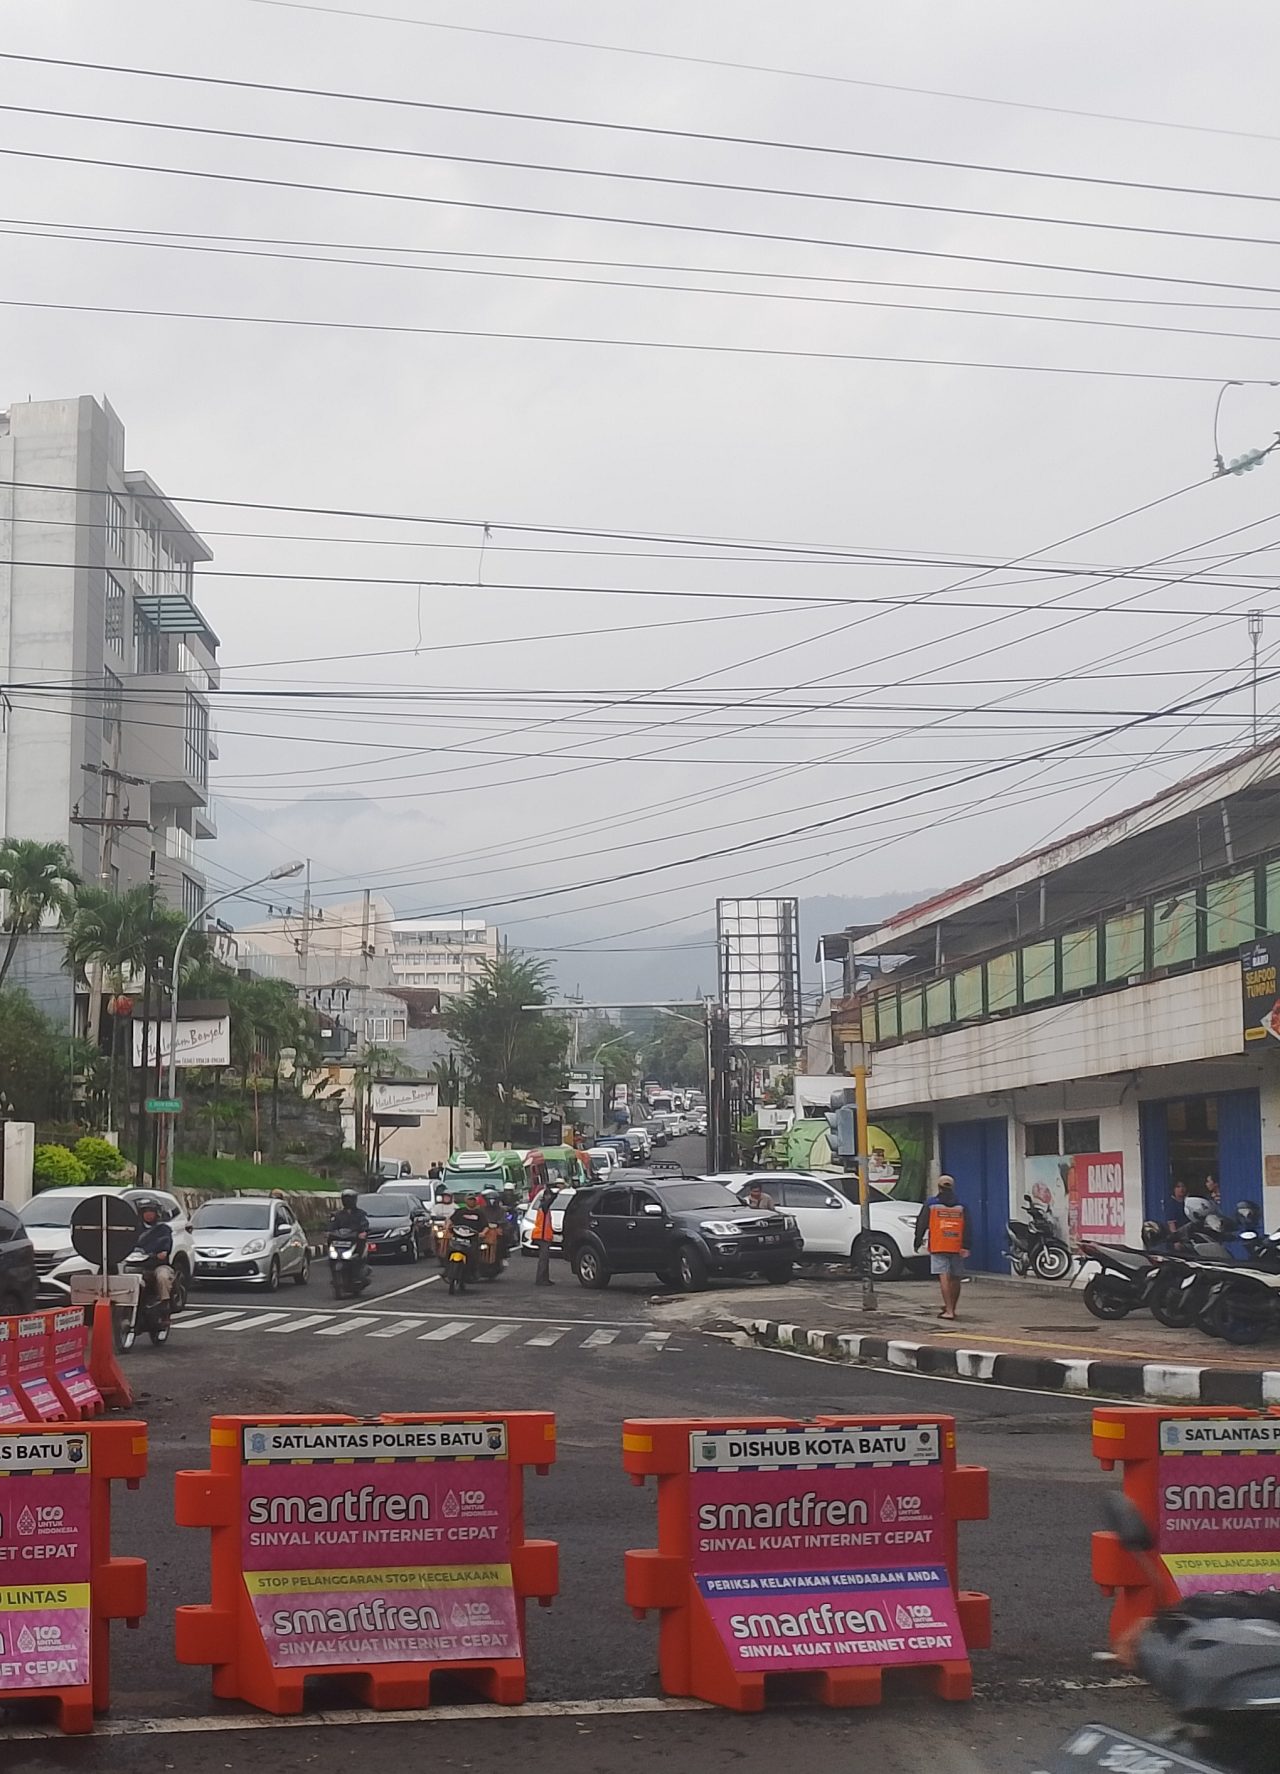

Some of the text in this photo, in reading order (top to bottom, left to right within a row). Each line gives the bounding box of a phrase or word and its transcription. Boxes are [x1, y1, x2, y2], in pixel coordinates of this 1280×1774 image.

[1246, 967, 1276, 985] SEAFOOD
[1088, 1163, 1122, 1193] BAKSO
[1081, 1197, 1108, 1226] ARIEF
[1110, 1197, 1124, 1227] 35
[272, 1432, 483, 1449] SATLANTAS POLRES BATU
[1185, 1428, 1270, 1441] SATLANTAS
[16, 1444, 63, 1460] BATU
[729, 1437, 906, 1458] DISHUB KOTA BATU
[248, 1485, 430, 1525] smartfren
[459, 1490, 485, 1505] 100
[896, 1496, 921, 1510] 100
[35, 1506, 64, 1521] 100
[698, 1492, 868, 1531] smartfren
[1166, 1518, 1220, 1531] SINYAL
[1222, 1517, 1262, 1530] KUAT
[250, 1526, 498, 1546] SINYAL KUAT INTERNET CEPAT
[699, 1530, 933, 1553] SINYAL KUAT INTERNET CEPAT
[22, 1543, 78, 1559] CEPAT
[1175, 1560, 1203, 1570] STOP
[258, 1570, 499, 1588] STOP PELANGGARAN STOP KECELAKAAN
[707, 1571, 940, 1592] PERIKSA KELAYAKAN KENDARAAN ANDA
[7, 1590, 67, 1605] LINTAS
[272, 1598, 441, 1636] smartfren
[730, 1603, 888, 1640] smartfren
[33, 1626, 61, 1640] 100
[279, 1634, 509, 1656] SINYAL KUAT INTERNET CEPAT
[739, 1635, 954, 1659] SINYAL KUAT INTERNET CEPAT
[25, 1659, 78, 1674] CEPAT
